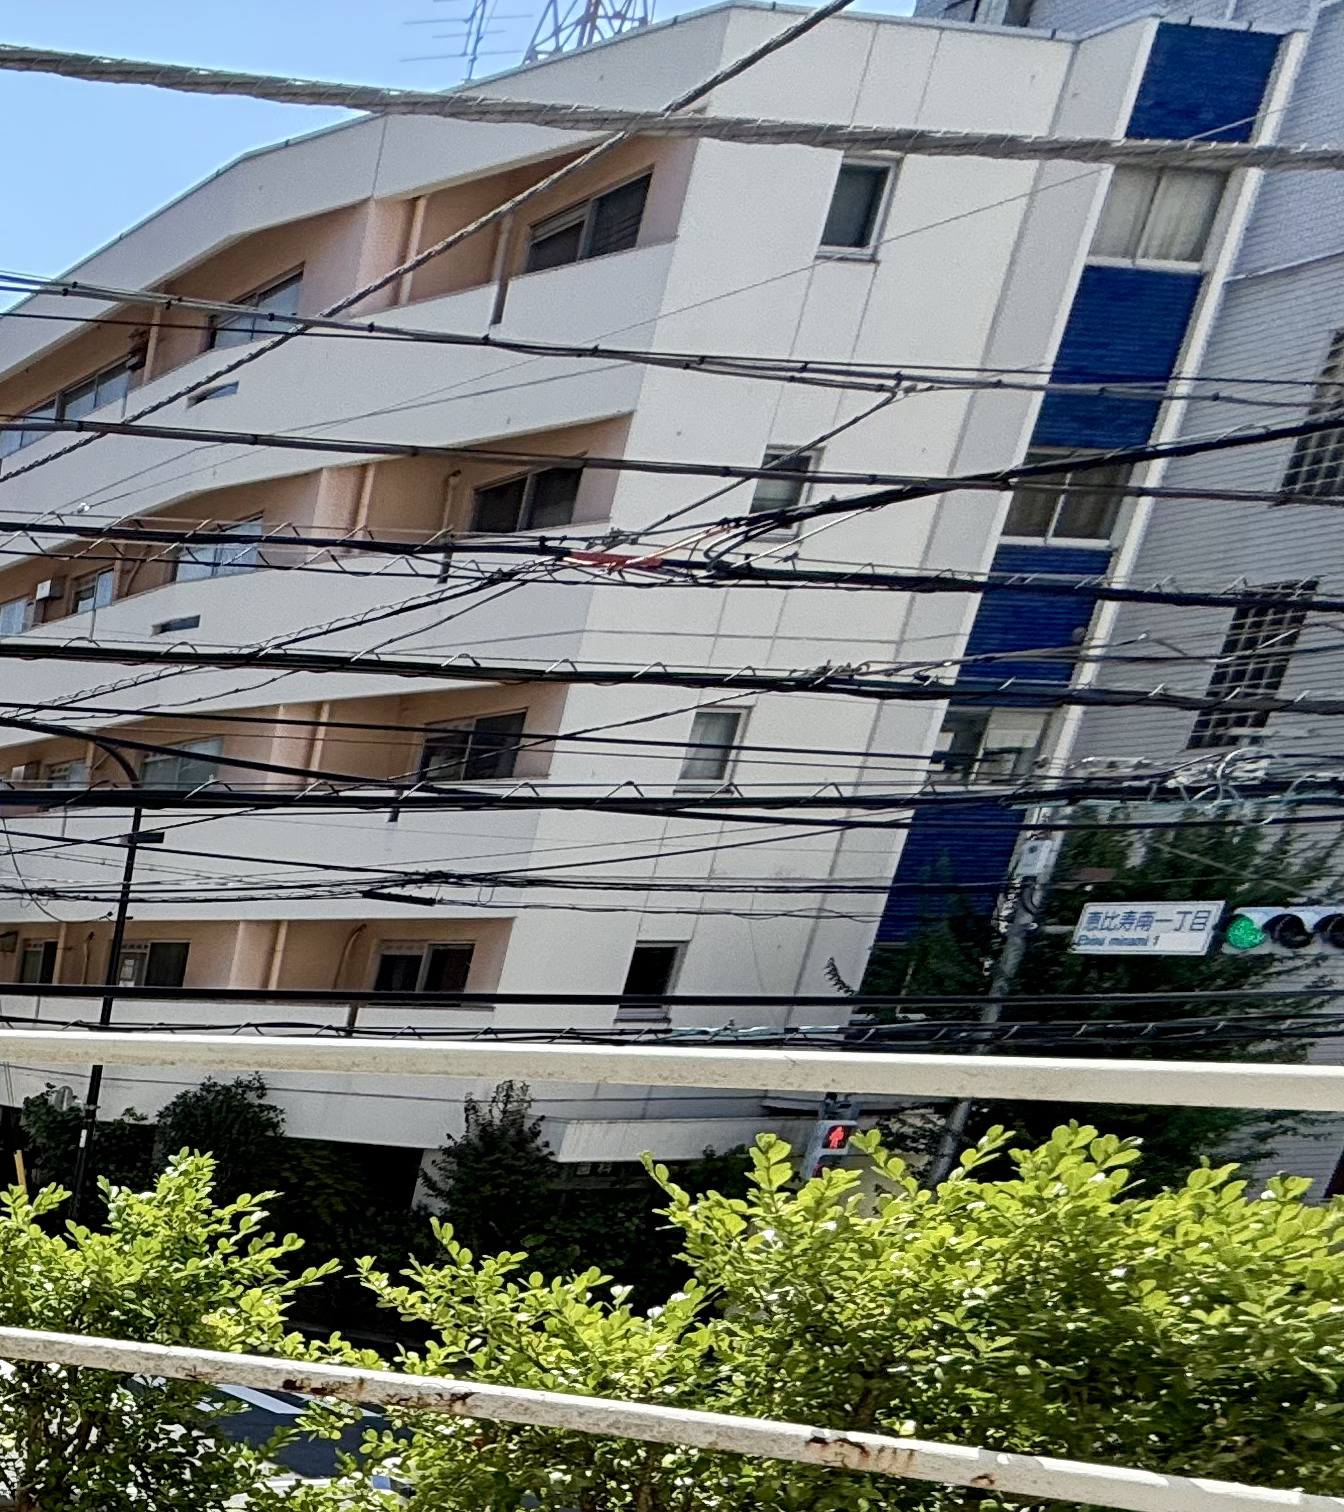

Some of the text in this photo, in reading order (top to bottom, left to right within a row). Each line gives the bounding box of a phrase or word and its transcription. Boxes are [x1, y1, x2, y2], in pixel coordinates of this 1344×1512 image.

[1083, 909, 1212, 932] 恵比寿南一丁目
